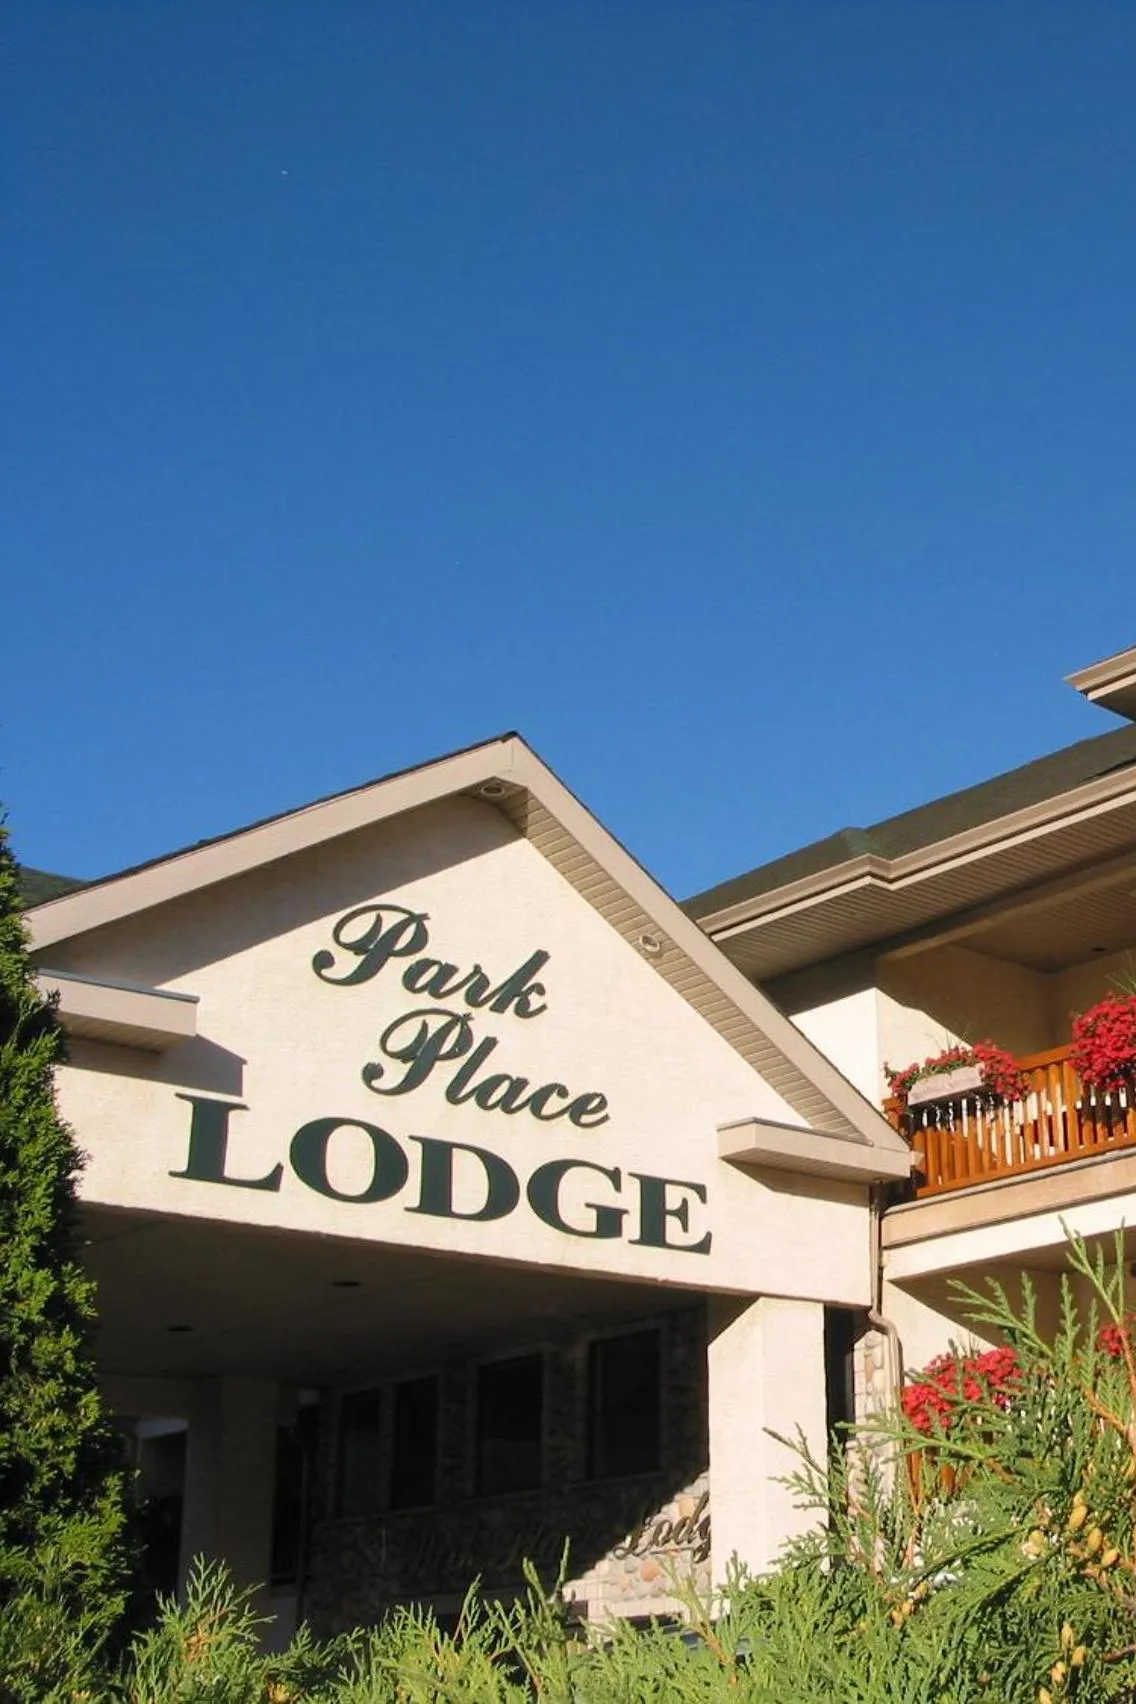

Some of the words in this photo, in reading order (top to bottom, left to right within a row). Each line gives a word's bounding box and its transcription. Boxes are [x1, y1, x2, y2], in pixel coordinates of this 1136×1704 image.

[312, 904, 550, 1019] Park
[362, 1008, 610, 1129] Place
[168, 1093, 713, 1256] LODGE
[612, 1490, 712, 1565] Lodg
